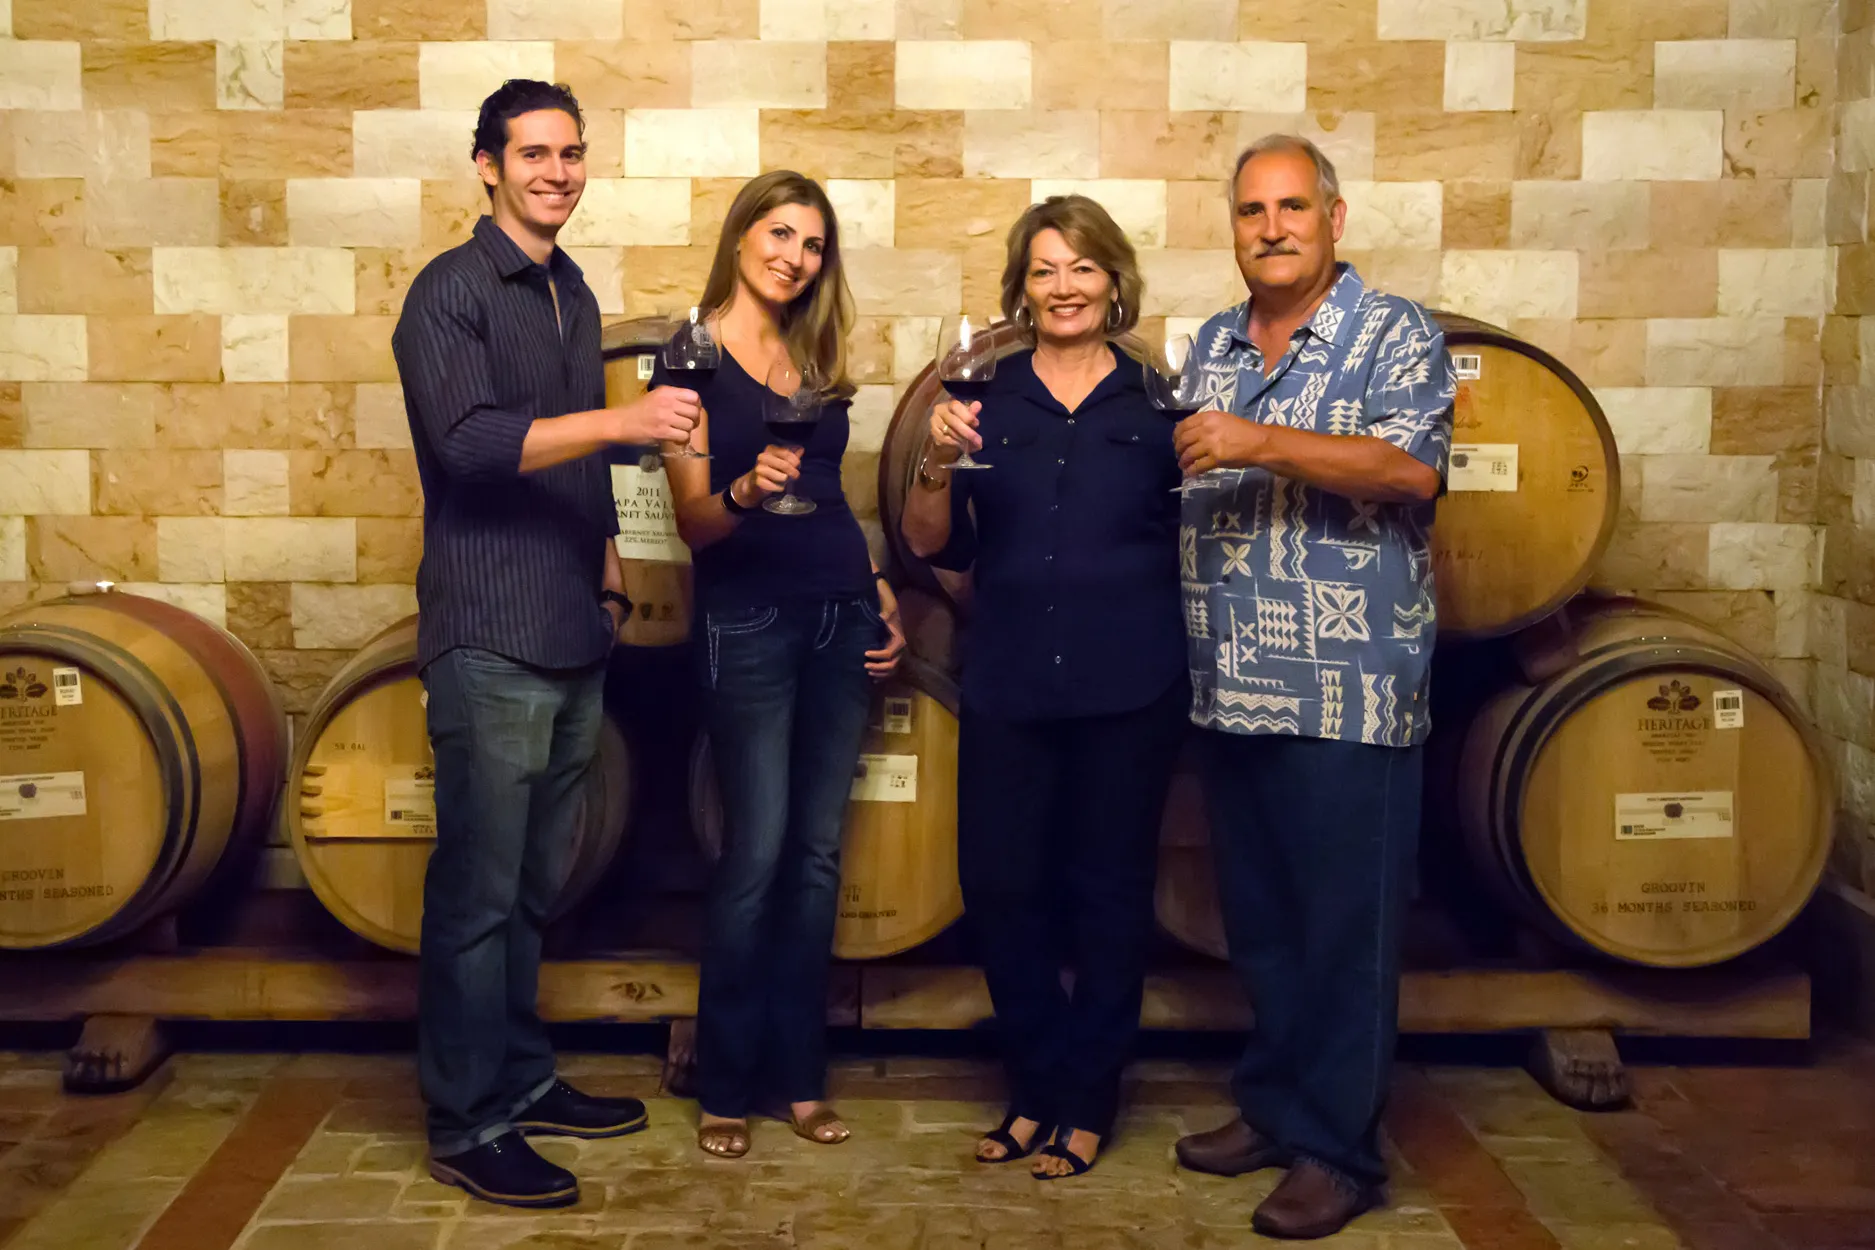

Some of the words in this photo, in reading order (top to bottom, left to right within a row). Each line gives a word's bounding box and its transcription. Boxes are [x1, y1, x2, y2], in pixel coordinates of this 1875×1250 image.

[636, 487, 661, 497] 2011
[615, 498, 638, 508] APA
[645, 499, 675, 509] VAL
[0, 705, 58, 719] ERITAGE
[1637, 717, 1710, 732] HERITAGE
[0, 889, 34, 901] NTHS
[43, 885, 114, 899] SEASONED
[1641, 881, 1706, 894] GROOVIN
[1617, 902, 1673, 914] MONTHS
[1682, 900, 1757, 913] SEASONED
